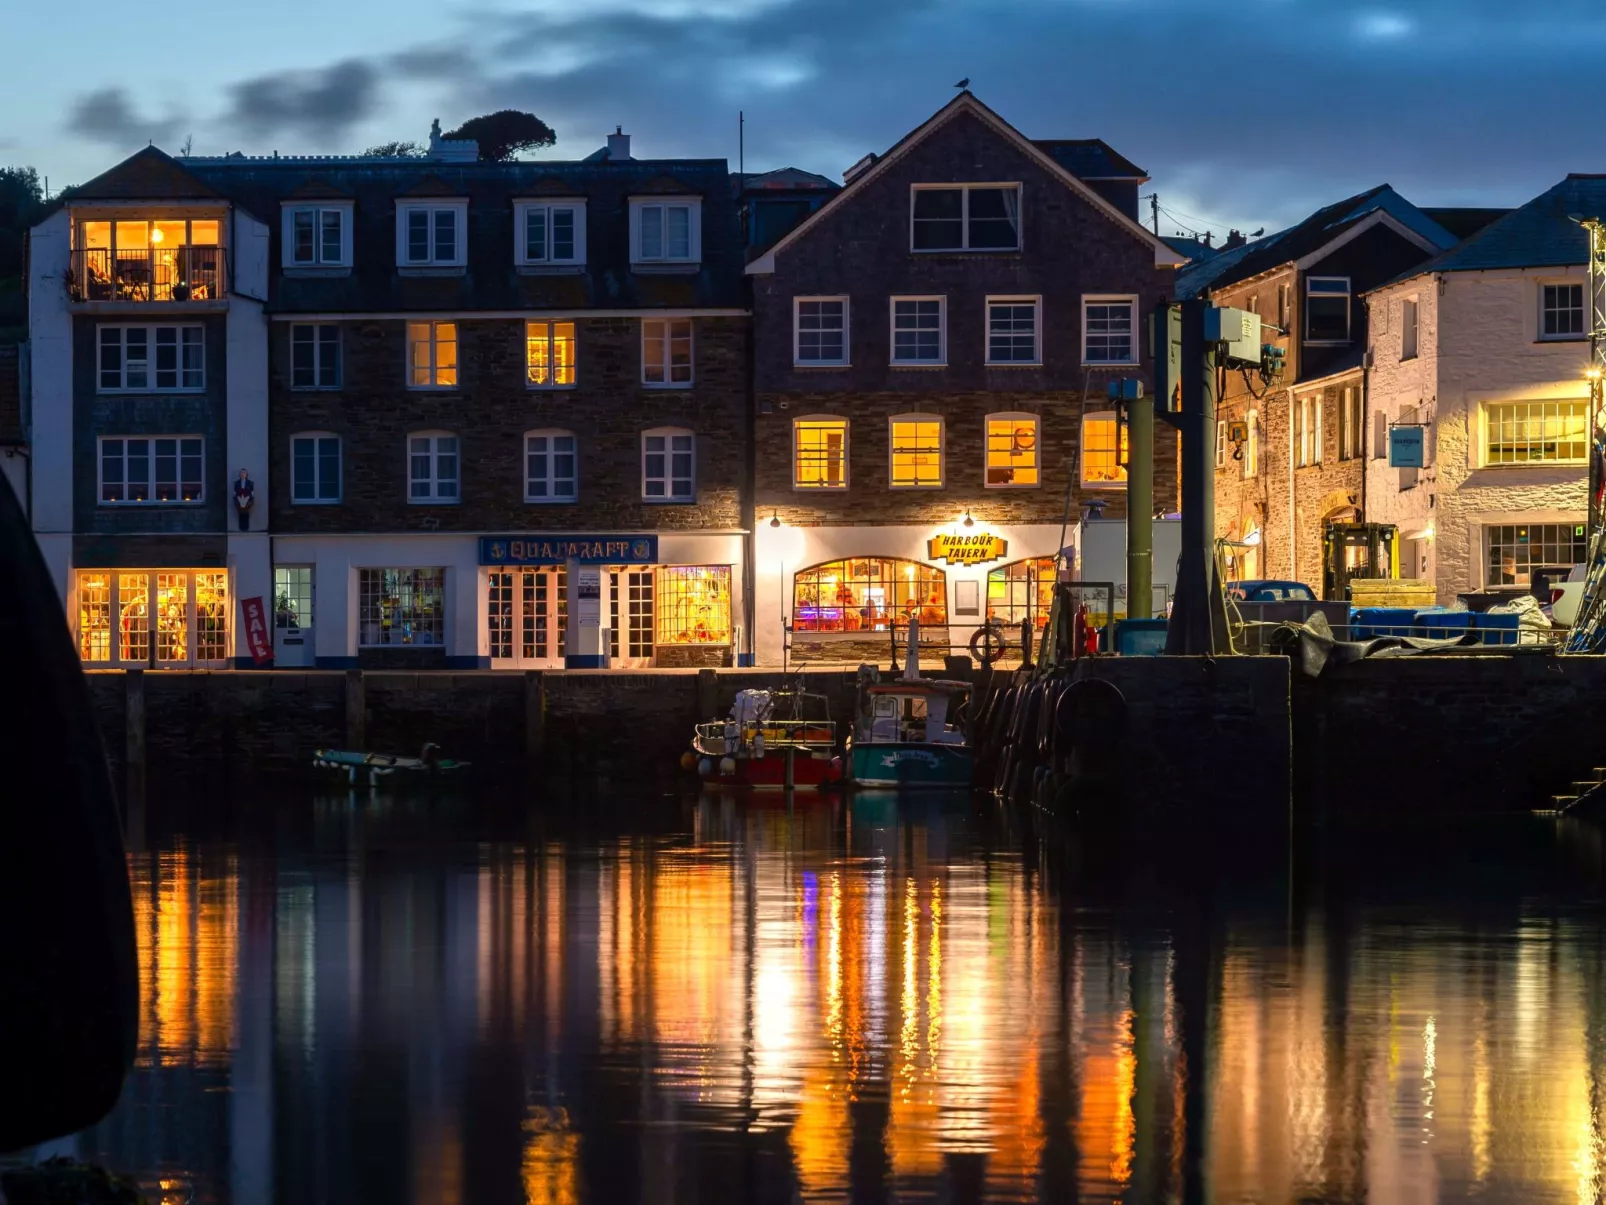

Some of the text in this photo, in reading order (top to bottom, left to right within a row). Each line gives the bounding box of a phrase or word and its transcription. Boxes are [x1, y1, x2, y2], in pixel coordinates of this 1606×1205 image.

[942, 535, 994, 546] HARBOUR
[948, 548, 988, 558] TAVERN
[248, 604, 267, 657] SALE
